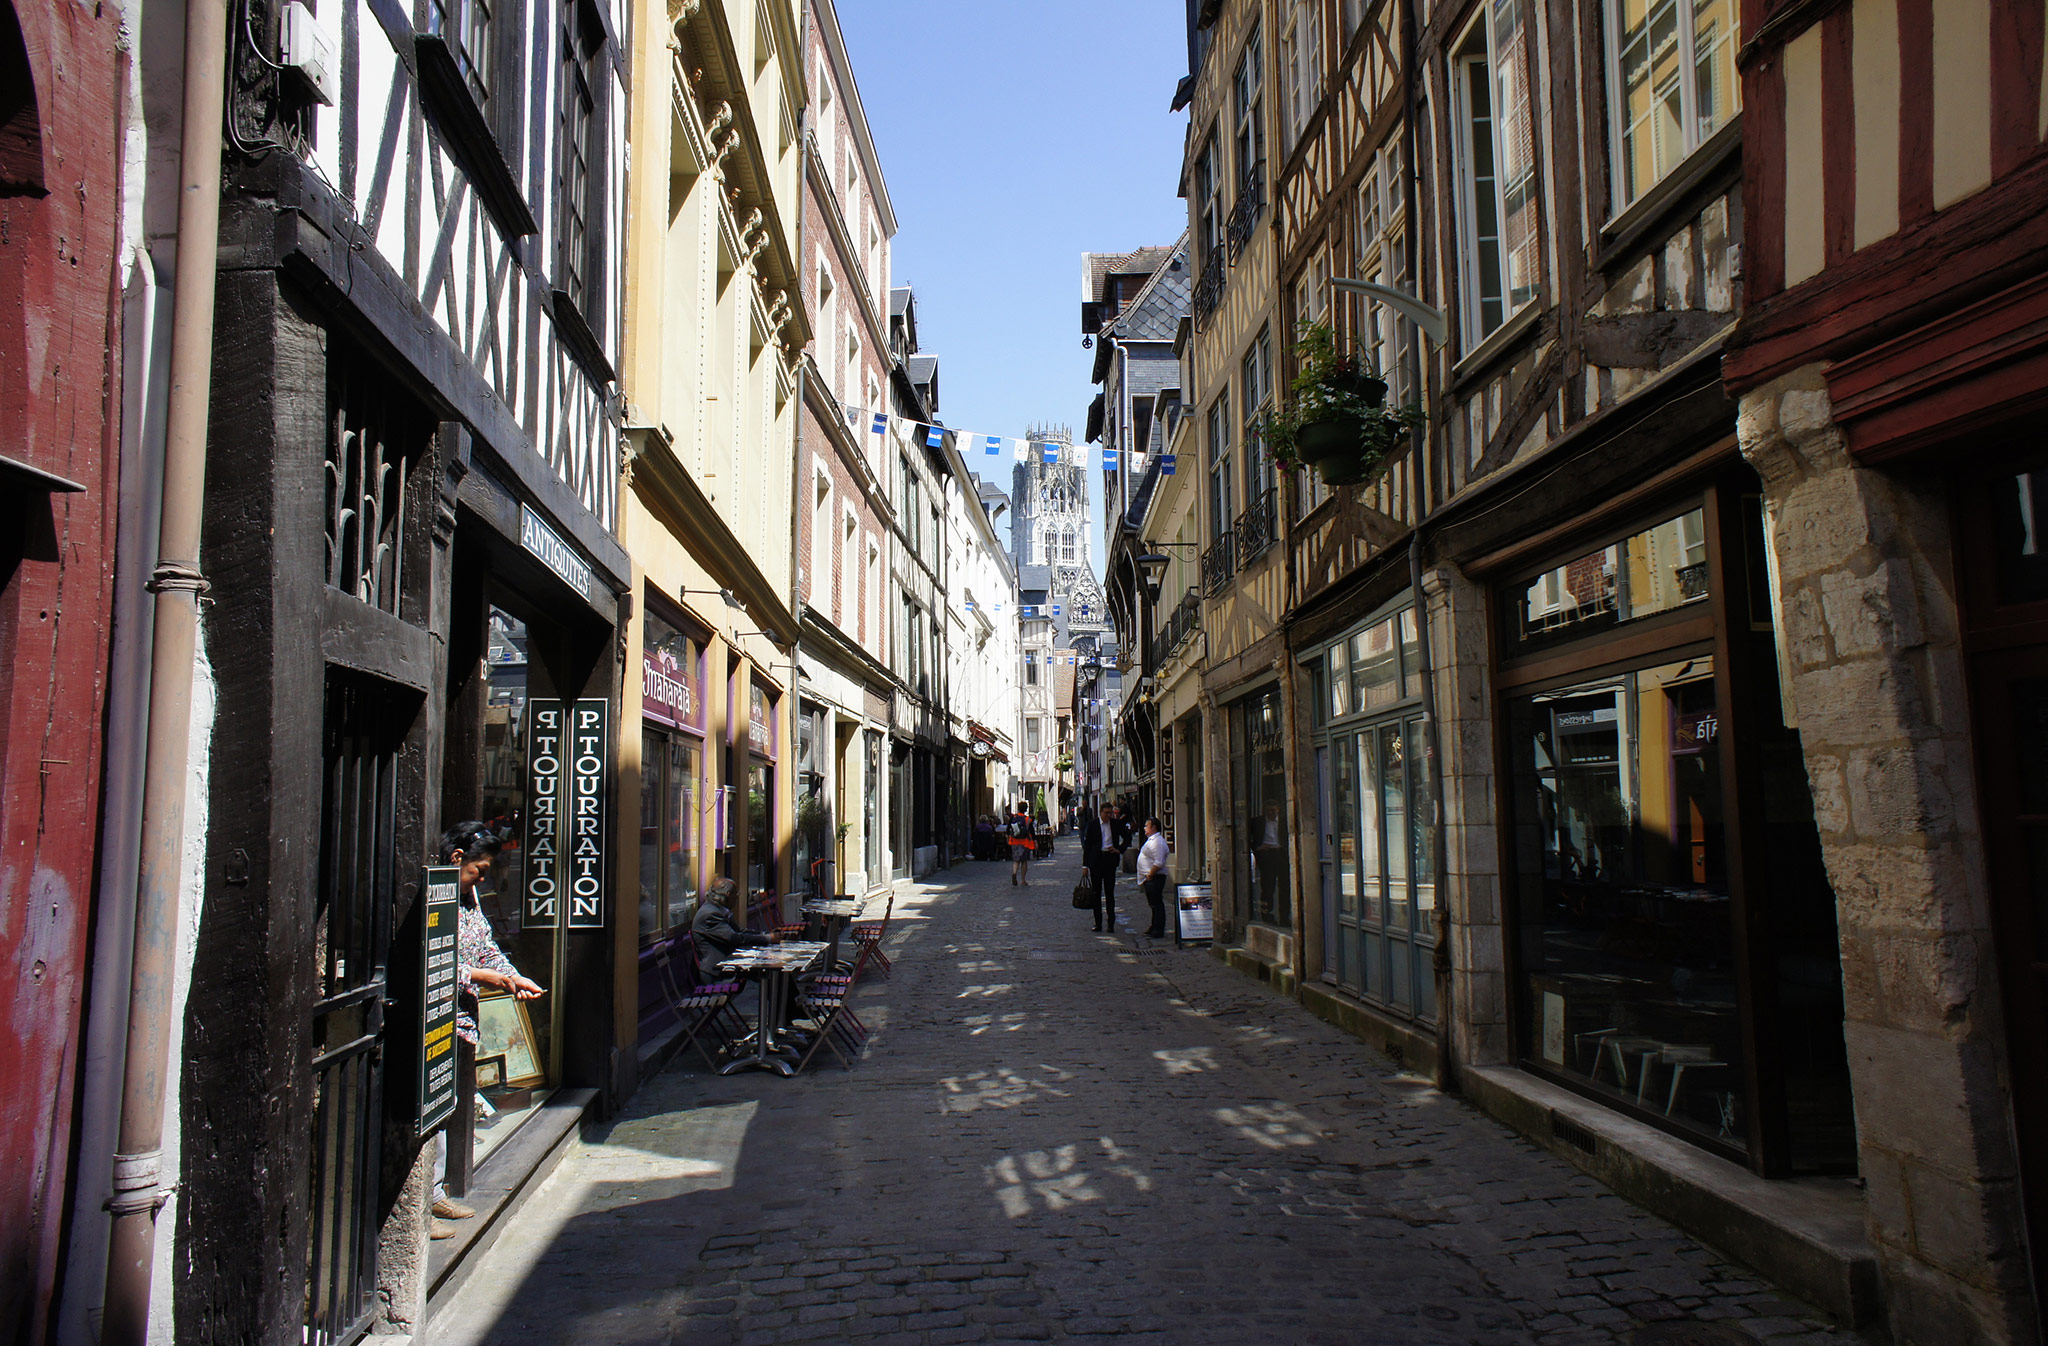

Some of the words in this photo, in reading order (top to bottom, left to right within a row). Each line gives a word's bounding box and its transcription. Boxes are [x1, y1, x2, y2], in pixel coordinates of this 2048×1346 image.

[523, 515, 589, 595] ANTIQUITES
[480, 658, 488, 681] 13
[578, 710, 600, 729] P.
[572, 735, 602, 916] TOURRATON
[1162, 737, 1174, 845] MUSIQUE
